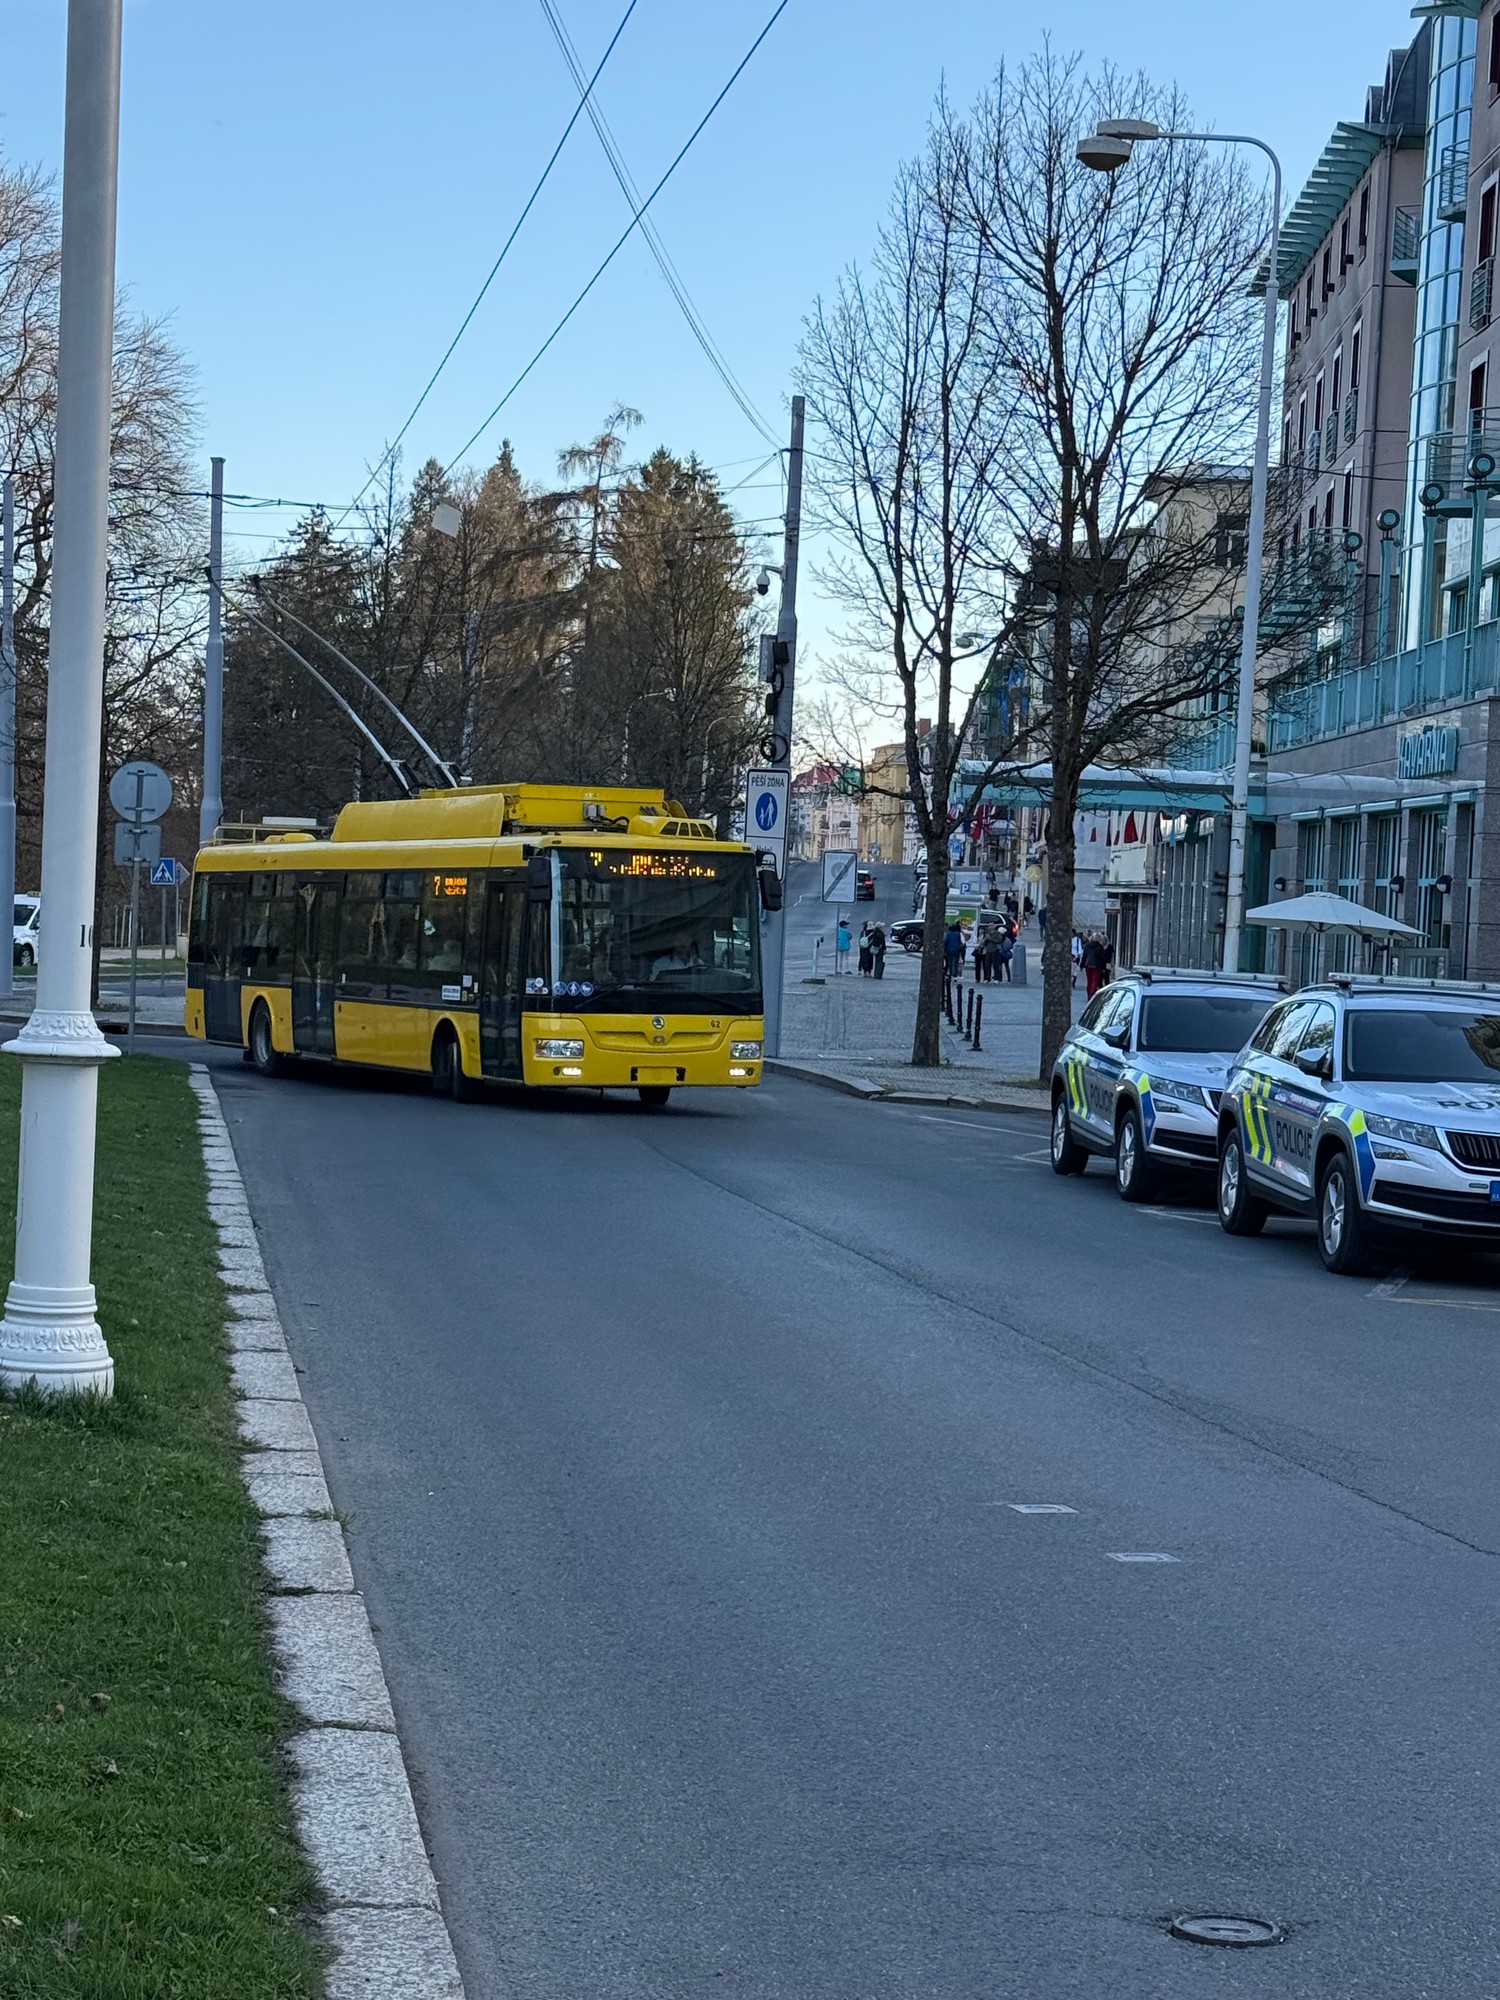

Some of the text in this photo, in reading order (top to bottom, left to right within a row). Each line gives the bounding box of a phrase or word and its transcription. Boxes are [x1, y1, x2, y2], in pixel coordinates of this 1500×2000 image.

[434, 875, 441, 896] 7
[710, 1019, 721, 1029] 62
[1276, 1120, 1313, 1160] POLICIE
